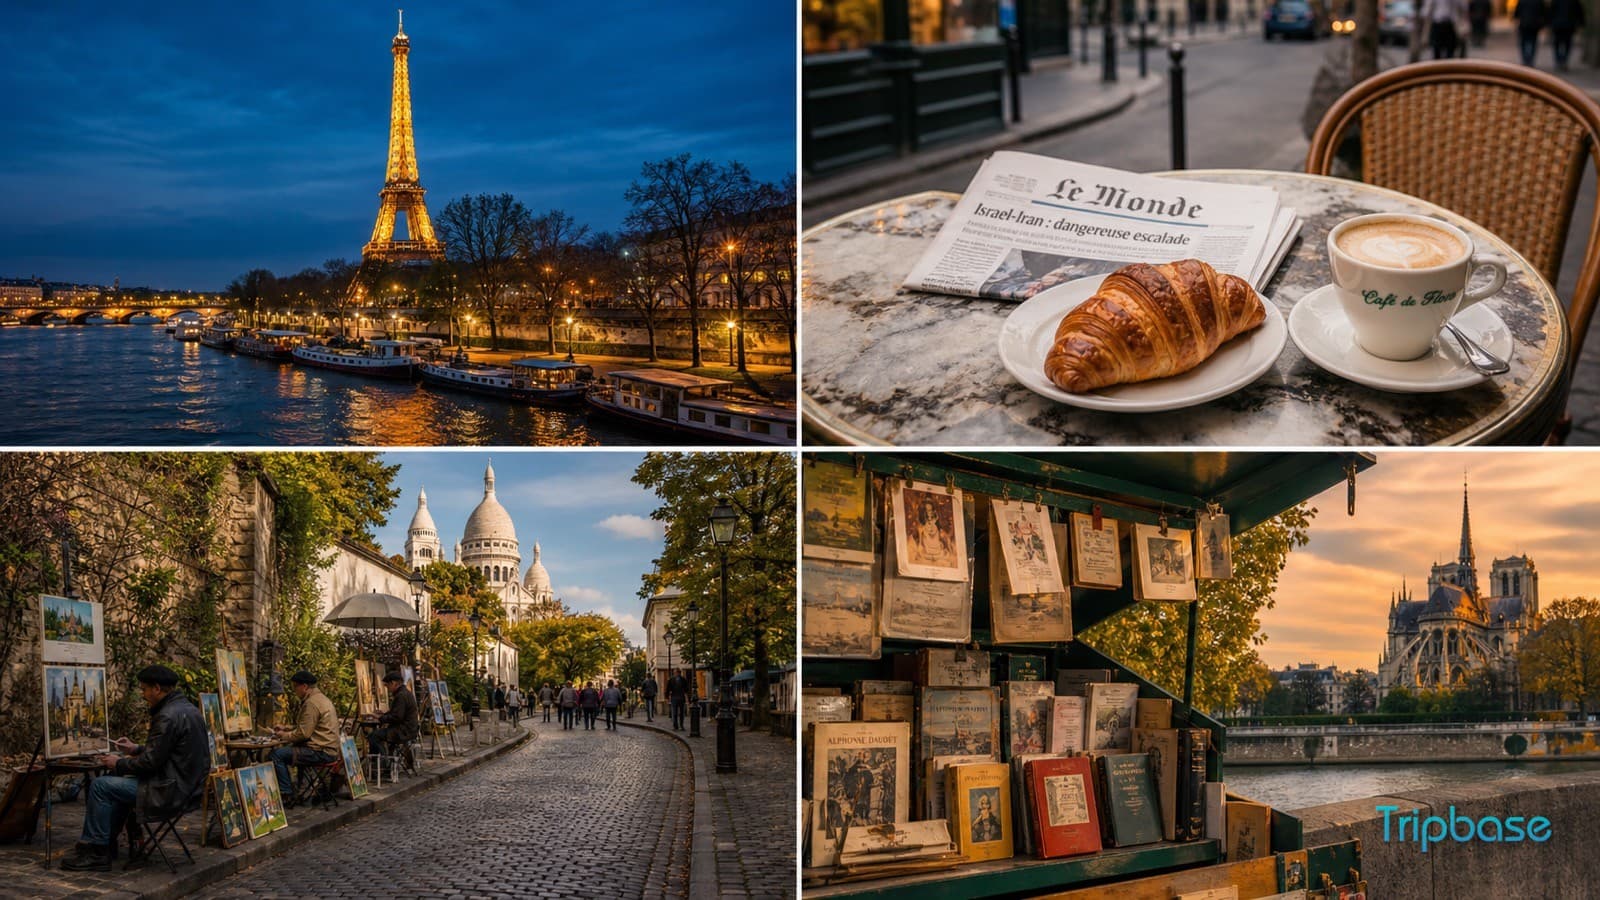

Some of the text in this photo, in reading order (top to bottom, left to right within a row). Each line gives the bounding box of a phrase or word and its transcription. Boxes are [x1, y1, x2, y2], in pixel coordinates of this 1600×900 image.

[1047, 178, 1084, 201] Le
[1084, 184, 1204, 219] Monde
[974, 203, 1044, 227] Israel-Iran
[1053, 218, 1131, 240] dangereuse
[1133, 232, 1191, 246] escalade
[1361, 289, 1397, 310] Café
[1401, 295, 1417, 307] de
